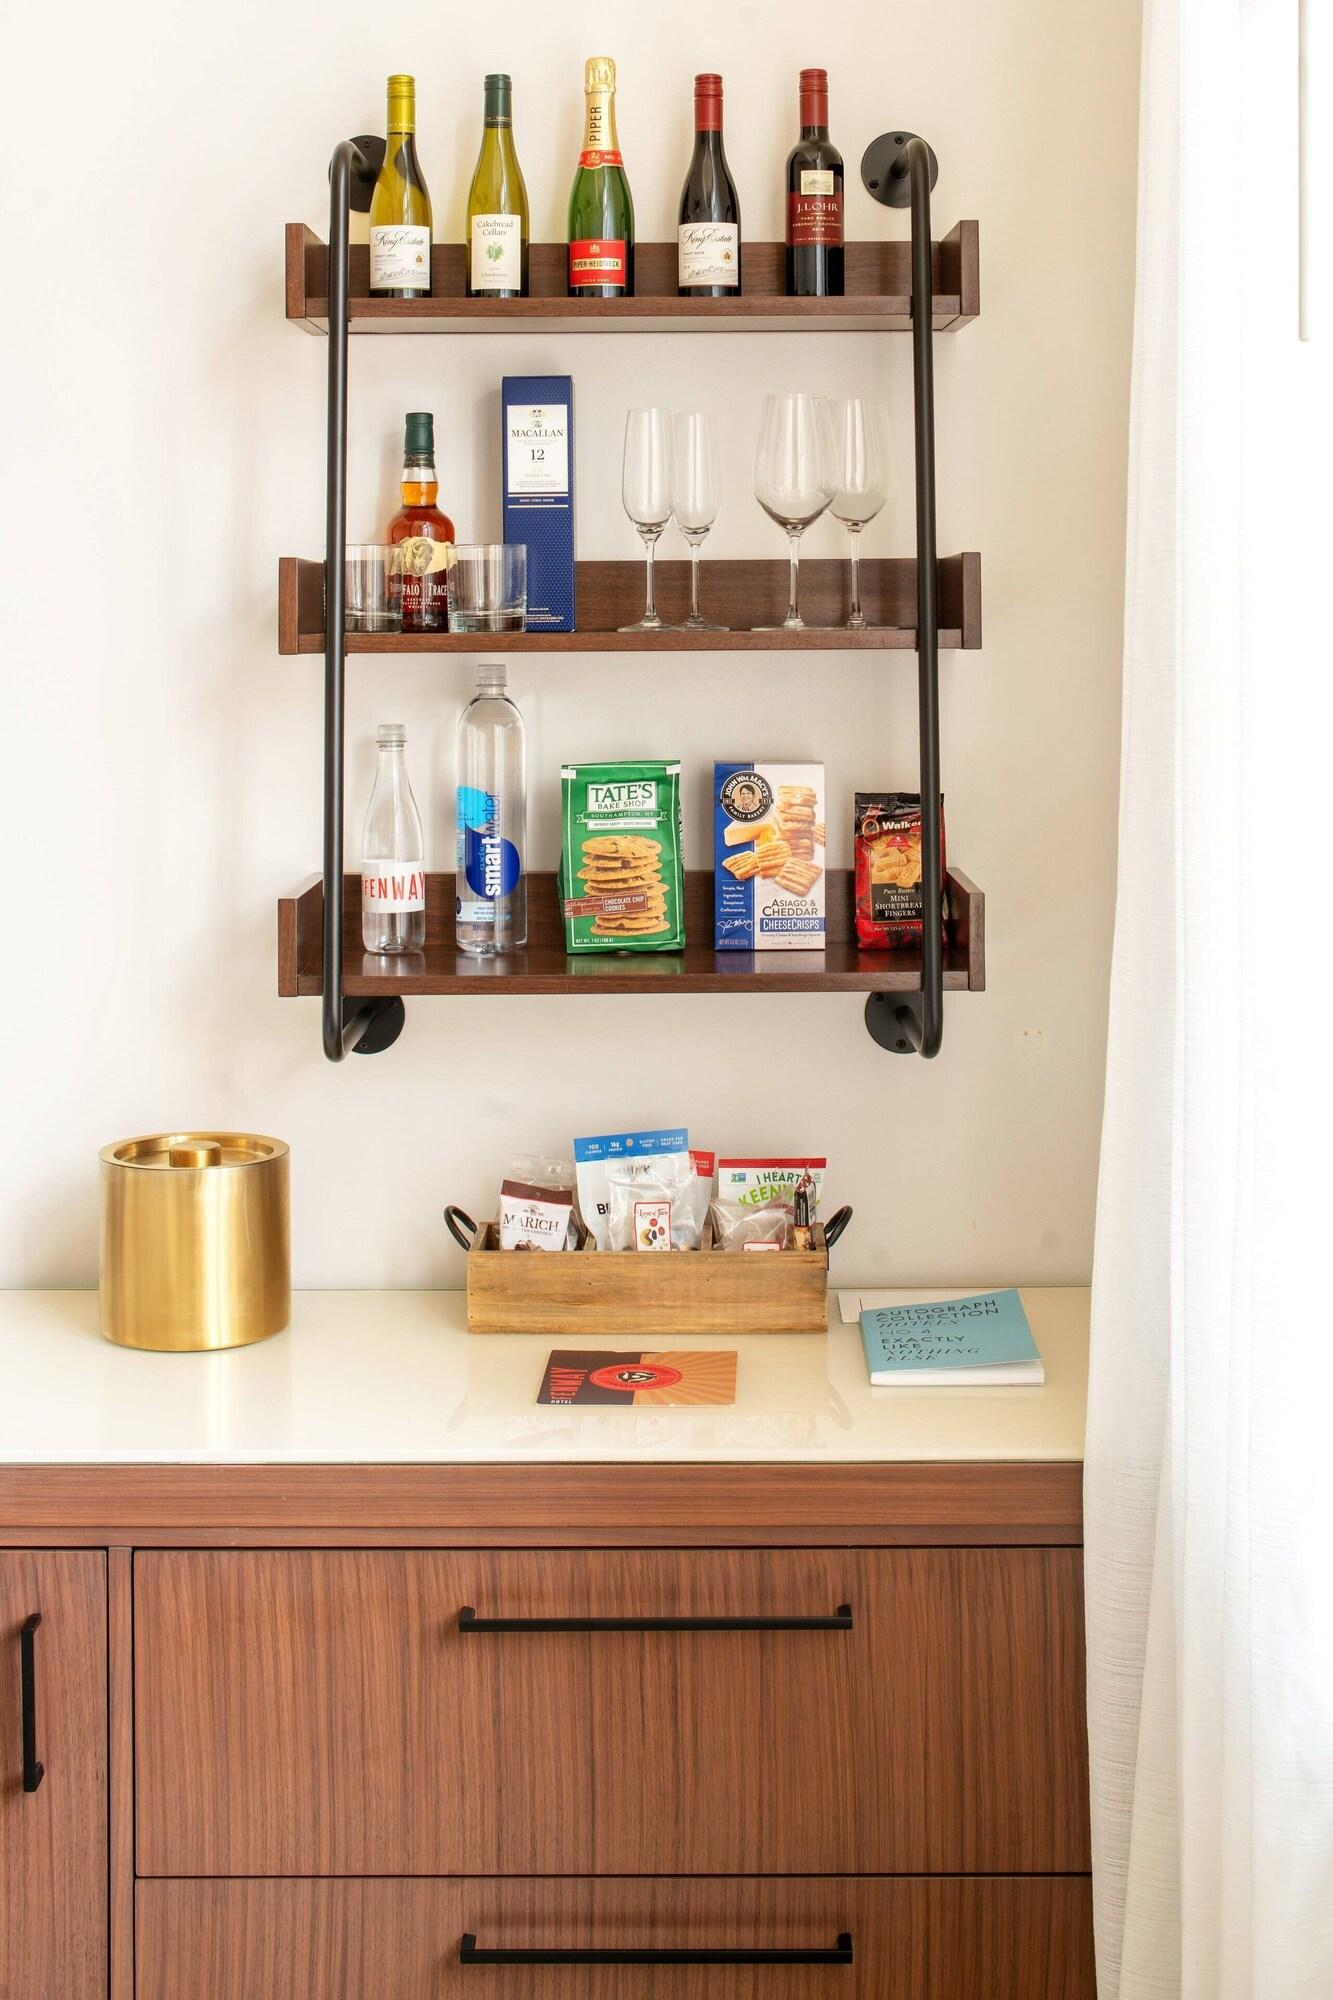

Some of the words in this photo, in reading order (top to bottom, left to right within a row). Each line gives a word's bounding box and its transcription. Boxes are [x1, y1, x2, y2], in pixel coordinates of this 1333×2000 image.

[589, 106, 602, 142] PIPER
[477, 220, 513, 228] Cakebread
[374, 230, 399, 252] King
[395, 231, 425, 246] Estate
[681, 227, 706, 249] King
[703, 228, 734, 243] Estate
[511, 430, 564, 438] MACALLAN
[530, 449, 545, 461] 12
[590, 784, 653, 803] TATE'S
[724, 778, 738, 797] JOHN
[597, 801, 620, 810] BAKE
[622, 800, 645, 808] SHOP
[747, 806, 766, 819] BAKERY
[364, 872, 425, 900] FENWAY
[604, 897, 631, 906] CHOCOLATE
[632, 895, 644, 903] CHIP
[771, 899, 807, 907] ASIAGO
[605, 904, 625, 912] COOKIES
[762, 906, 818, 917] CHEDDAR
[763, 919, 820, 931] CHEESECRISPS
[756, 1175, 761, 1184] I
[763, 1171, 803, 1184] HEART
[503, 1213, 561, 1232] MARICH
[876, 1300, 996, 1317] AUTOGRAPH
[876, 1308, 999, 1322] COLLECTION
[879, 1320, 958, 1328] HOTELS
[550, 1367, 588, 1399] FENWAY
